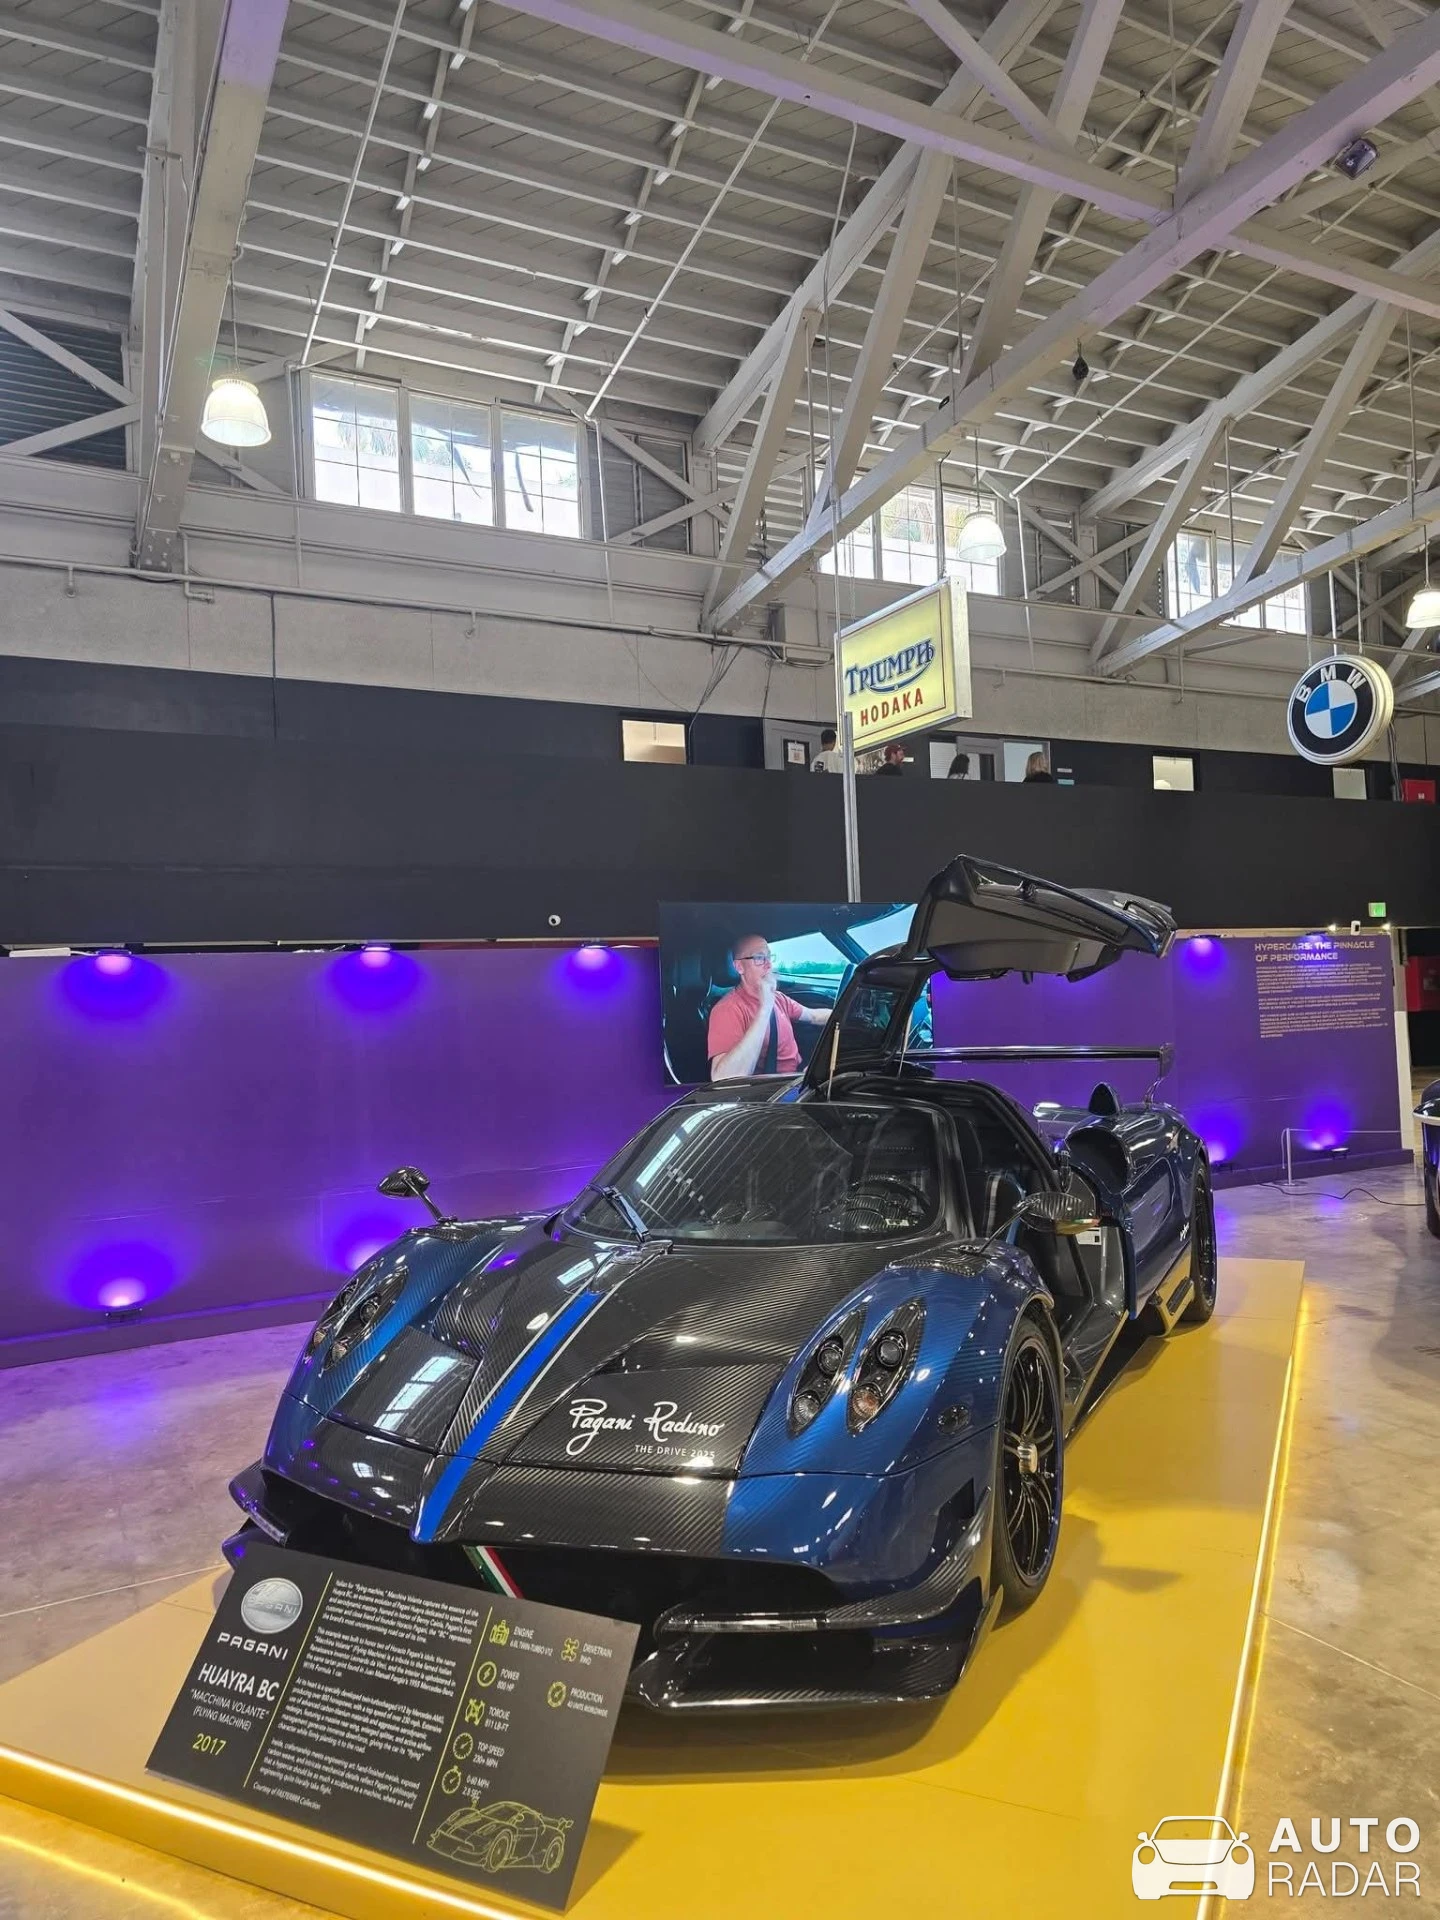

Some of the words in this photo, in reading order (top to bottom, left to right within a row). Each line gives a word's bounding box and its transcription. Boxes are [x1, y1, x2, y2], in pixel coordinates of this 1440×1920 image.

[845, 640, 935, 696] TRIUMPH
[1296, 664, 1367, 703] BMW
[860, 687, 924, 727] HODAKA
[1254, 942, 1313, 951] HYPERCARS:
[1315, 942, 1332, 950] THE
[1334, 941, 1375, 949] PINNACLE
[1256, 954, 1269, 962] OF
[1270, 952, 1338, 962] PERFORMANCE
[566, 1399, 636, 1456] Pagani
[643, 1401, 725, 1442] Raduno
[635, 1445, 653, 1454] THE
[656, 1447, 687, 1457] DRIVE
[513, 1626, 534, 1639] ENGINE
[217, 1632, 288, 1660] PAGANI
[582, 1643, 612, 1658] DRIVETRAIN
[500, 1668, 520, 1680] POWER
[198, 1663, 254, 1695] HUAYRA
[256, 1679, 279, 1701] BC
[505, 1683, 515, 1691] HP
[570, 1687, 603, 1704] PRODUCTION
[192, 1705, 218, 1720] (FLYING
[217, 1713, 251, 1731] MACHINE)
[488, 1706, 510, 1720] TORQUE
[192, 1733, 226, 1755] 2017
[477, 1741, 489, 1752] TOP
[487, 1744, 505, 1757] SPEED
[485, 1757, 498, 1768] MPH
[476, 1777, 490, 1788] MPH
